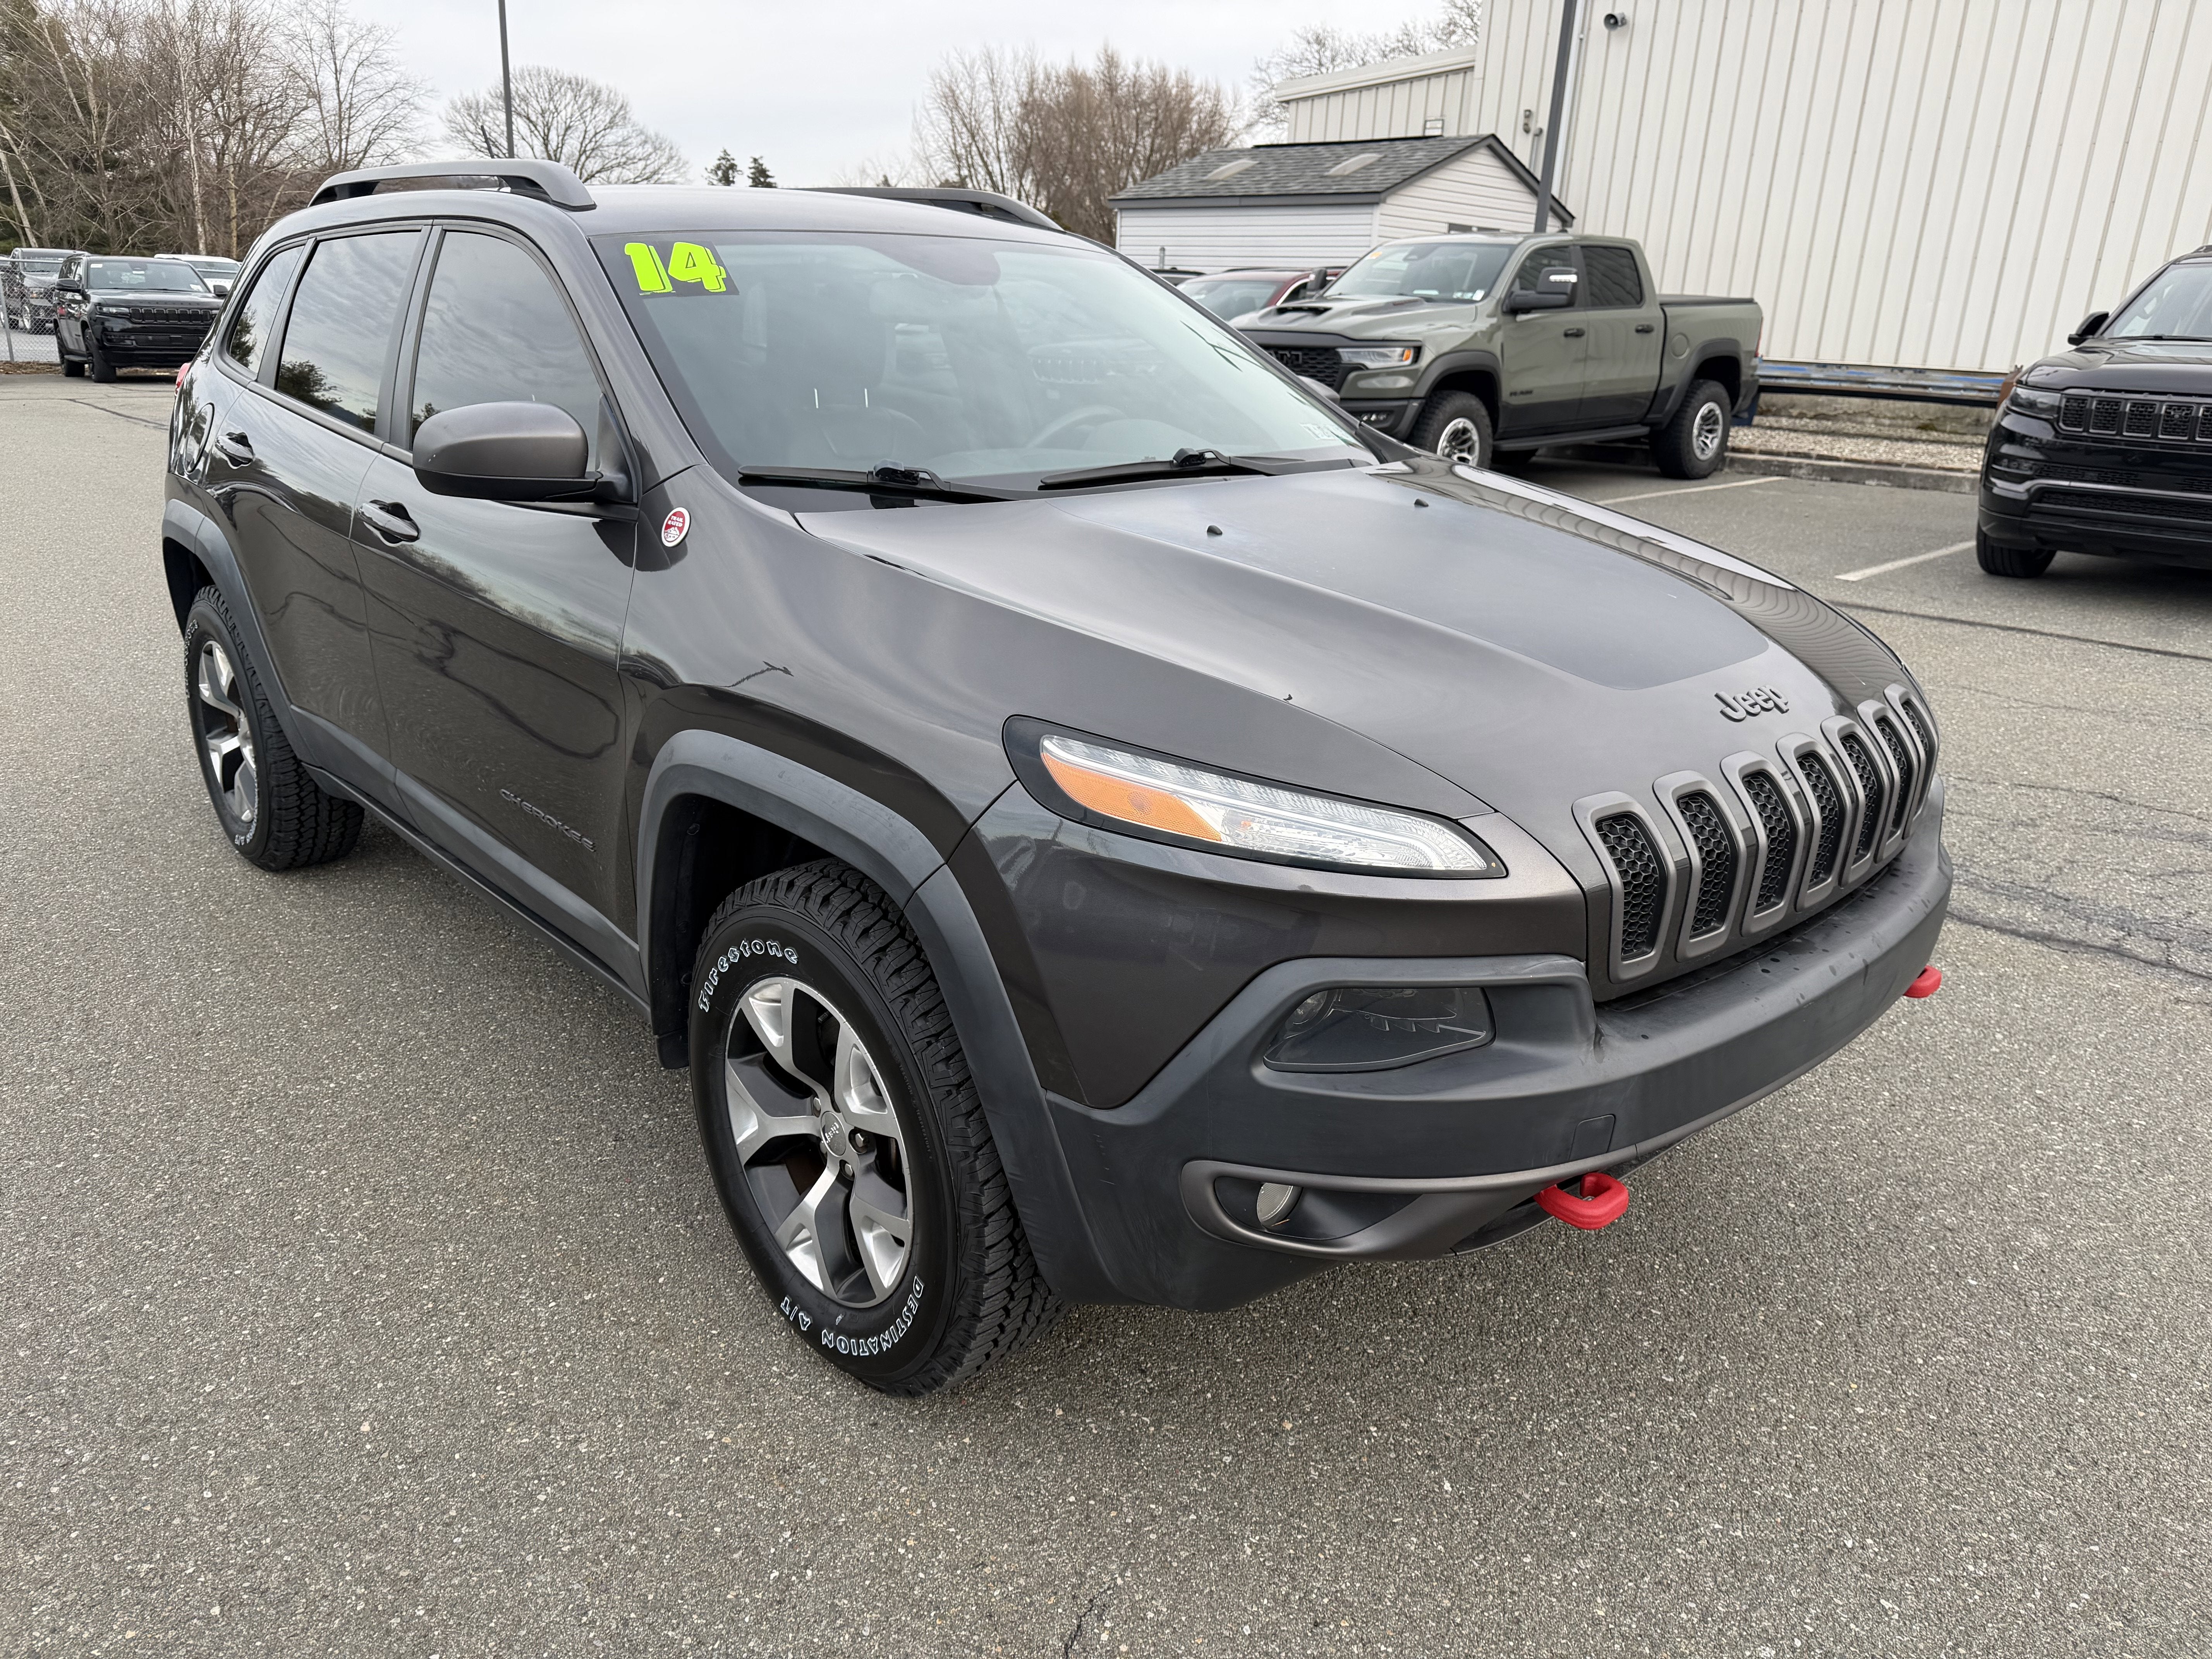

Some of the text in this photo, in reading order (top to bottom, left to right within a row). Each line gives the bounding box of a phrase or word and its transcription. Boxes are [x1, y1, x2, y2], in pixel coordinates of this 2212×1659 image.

[624, 242, 726, 293] 14
[1714, 685, 1789, 723] Jeep
[500, 789, 596, 852] CHEROKEE
[698, 938, 799, 1013] Firestone
[780, 1274, 924, 1356] DESTINATION A/T
